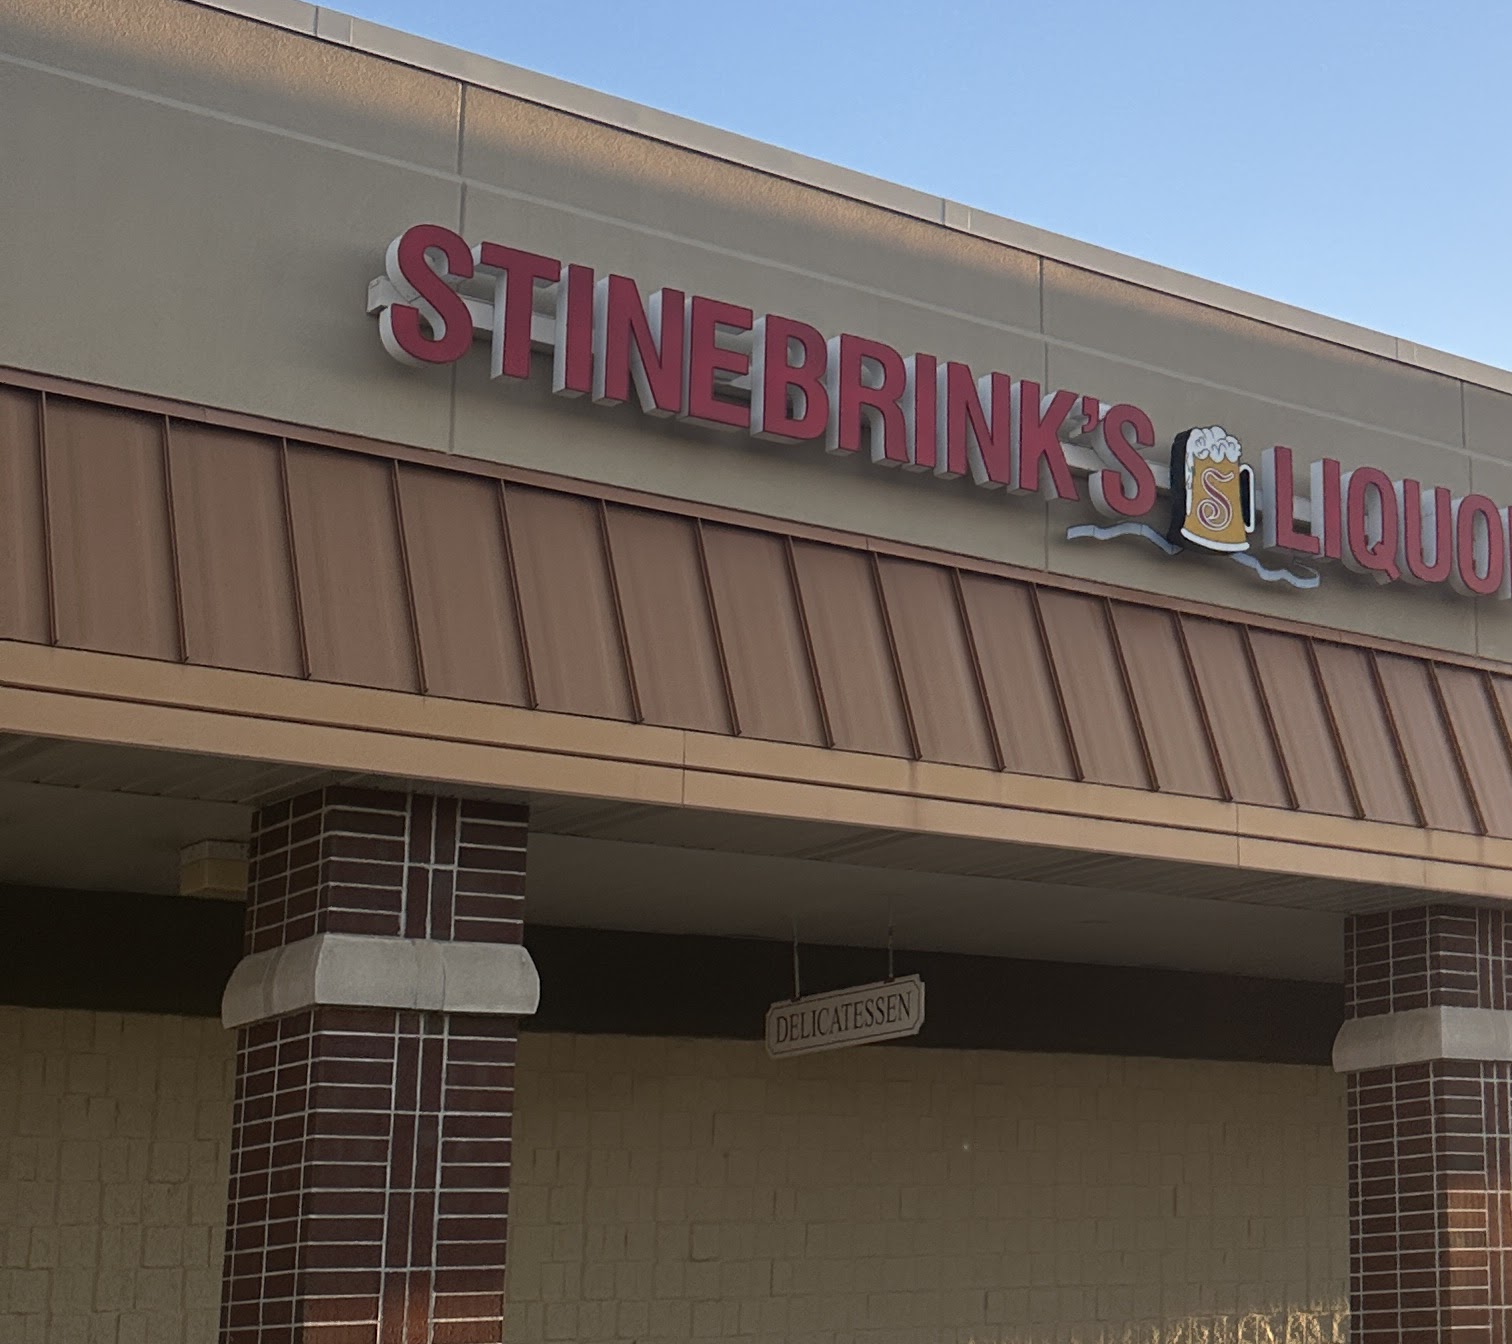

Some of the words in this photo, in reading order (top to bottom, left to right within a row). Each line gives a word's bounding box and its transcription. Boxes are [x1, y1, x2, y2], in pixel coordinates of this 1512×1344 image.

[385, 223, 1156, 518] STINEBRINK'S
[1197, 467, 1234, 531] S
[776, 990, 912, 1044] DELICATESSEN
